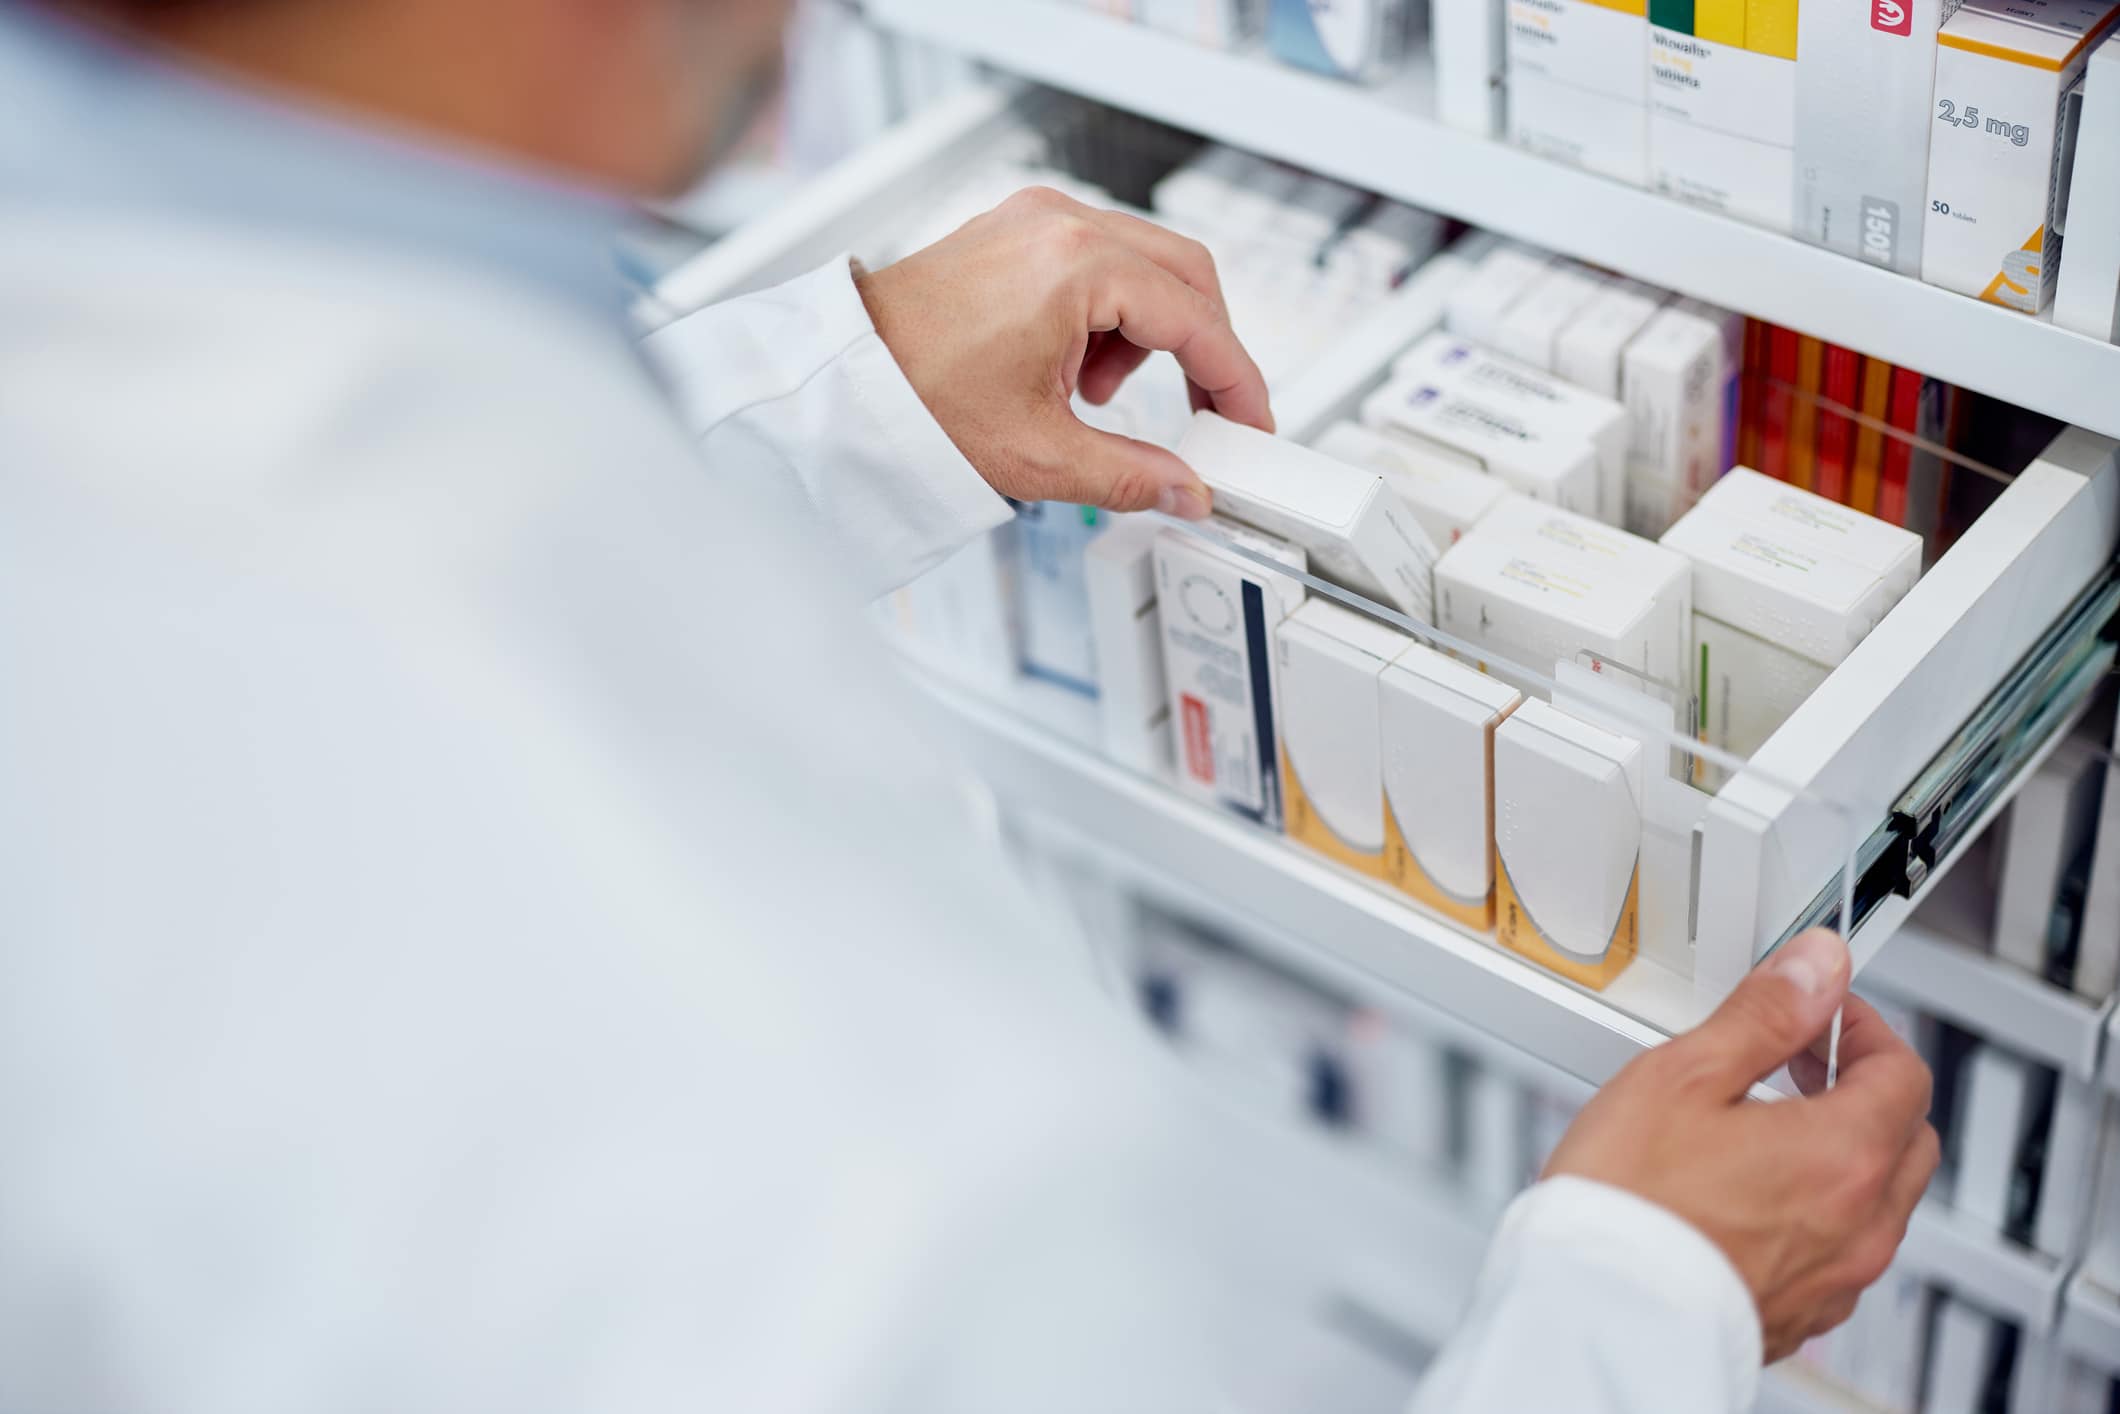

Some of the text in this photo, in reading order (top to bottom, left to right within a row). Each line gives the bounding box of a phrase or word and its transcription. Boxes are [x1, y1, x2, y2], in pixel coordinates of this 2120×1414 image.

[1937, 99, 2030, 147] 2,5 mg
[1931, 200, 1950, 215] 50
